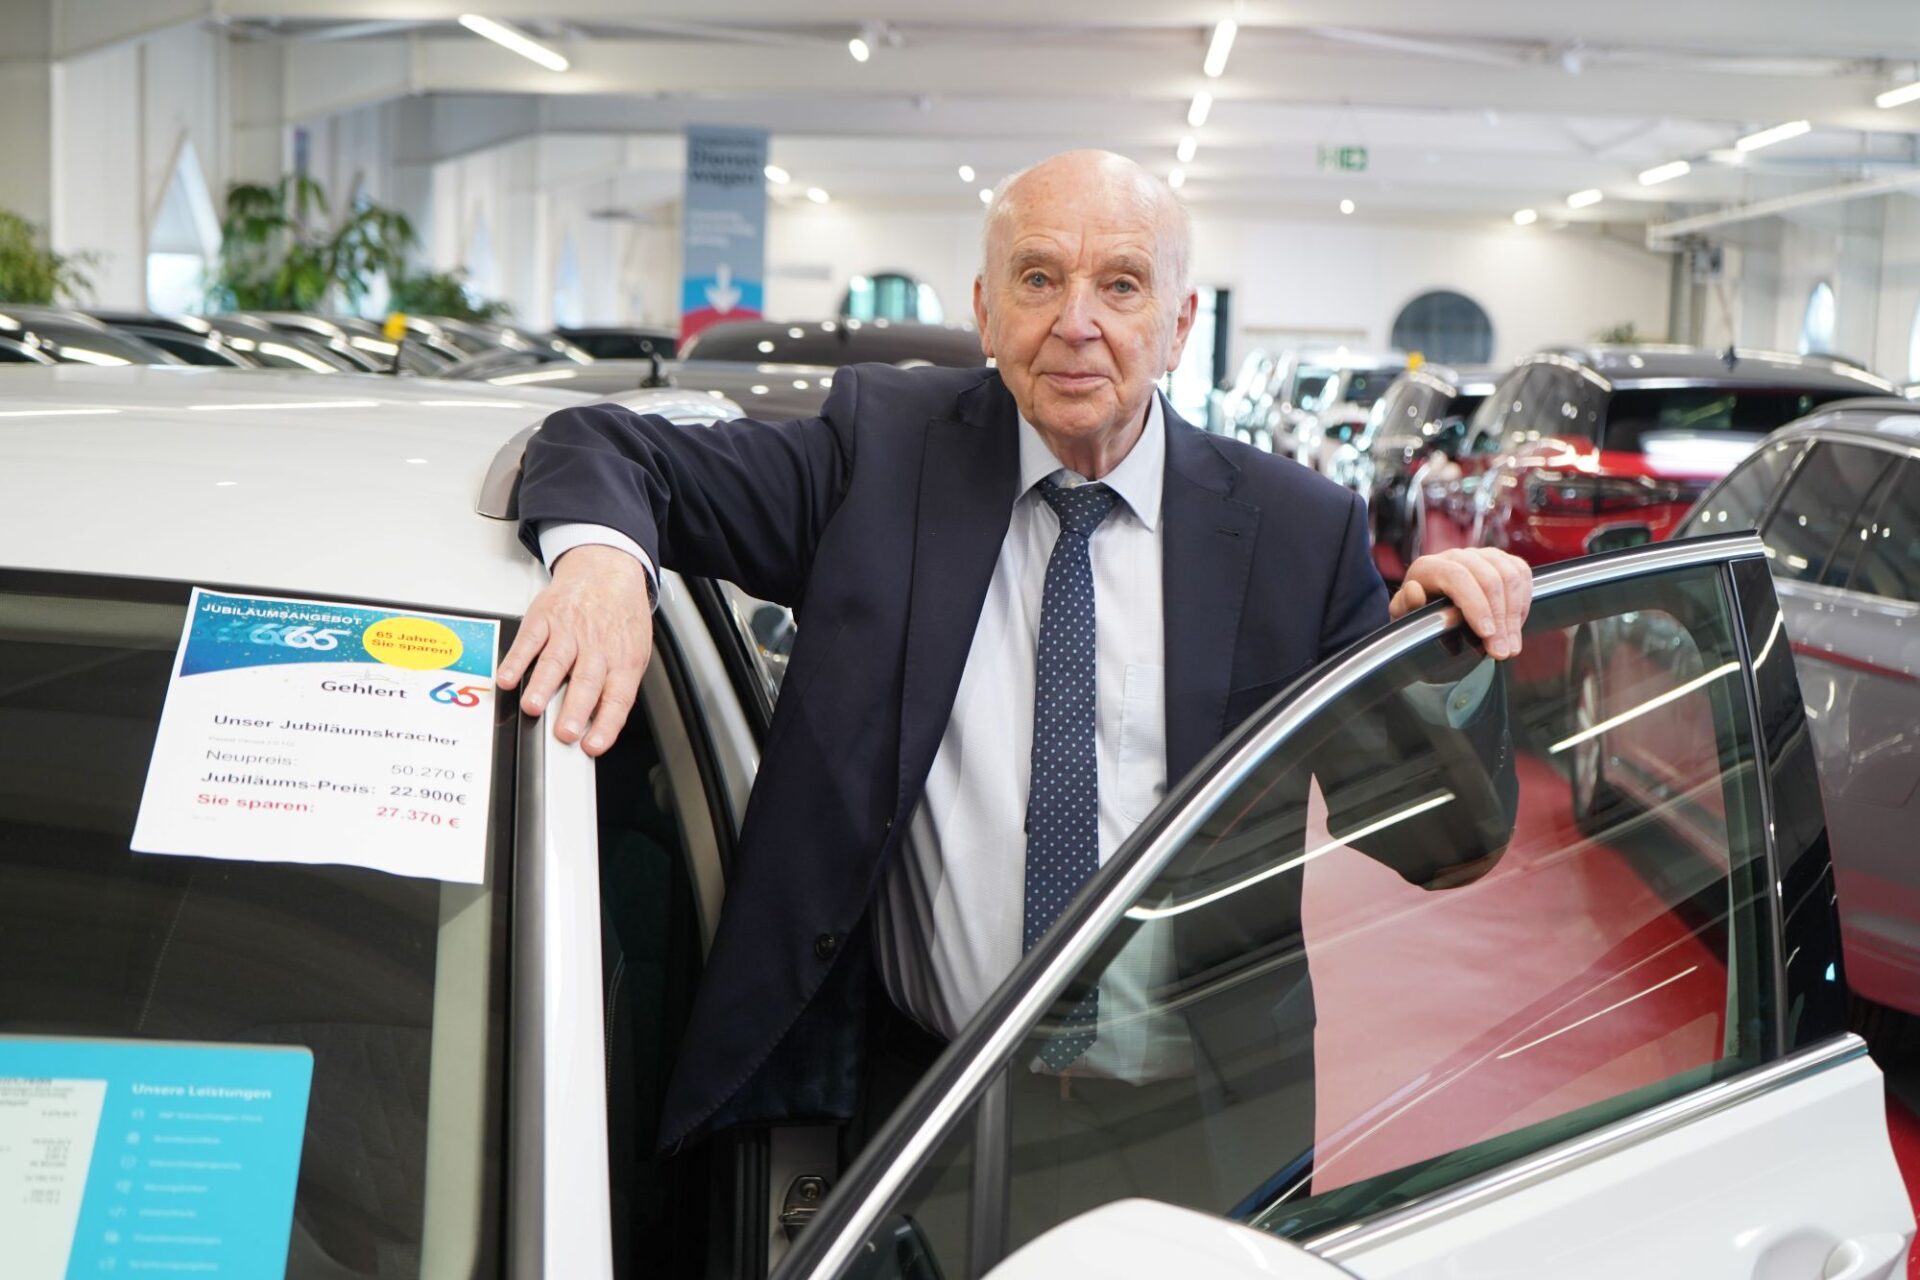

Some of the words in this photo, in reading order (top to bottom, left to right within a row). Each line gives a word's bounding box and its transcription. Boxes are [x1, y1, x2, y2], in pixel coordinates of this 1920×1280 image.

[202, 602, 362, 625] JUBILÄUMSANGEBOT
[371, 638, 395, 649] Sie
[398, 643, 454, 656] sparen!
[376, 630, 394, 640] 65
[397, 633, 438, 645] Jahre
[321, 680, 408, 699] Gehlert
[429, 681, 491, 708] 65
[214, 714, 274, 728] Unser
[280, 720, 460, 747] Jubiläumskracher
[206, 749, 299, 768] Neupreis:
[391, 764, 456, 781] 50.270
[462, 771, 474, 783] €
[201, 771, 377, 795] Jubiläums-Preis:
[389, 785, 468, 806] 22.900€
[197, 793, 230, 807] Sie
[236, 798, 315, 814] sparen:
[376, 806, 442, 826] 27.370
[449, 817, 461, 829] €
[132, 1082, 186, 1097] Unsere
[188, 1084, 272, 1101] Leistungen
